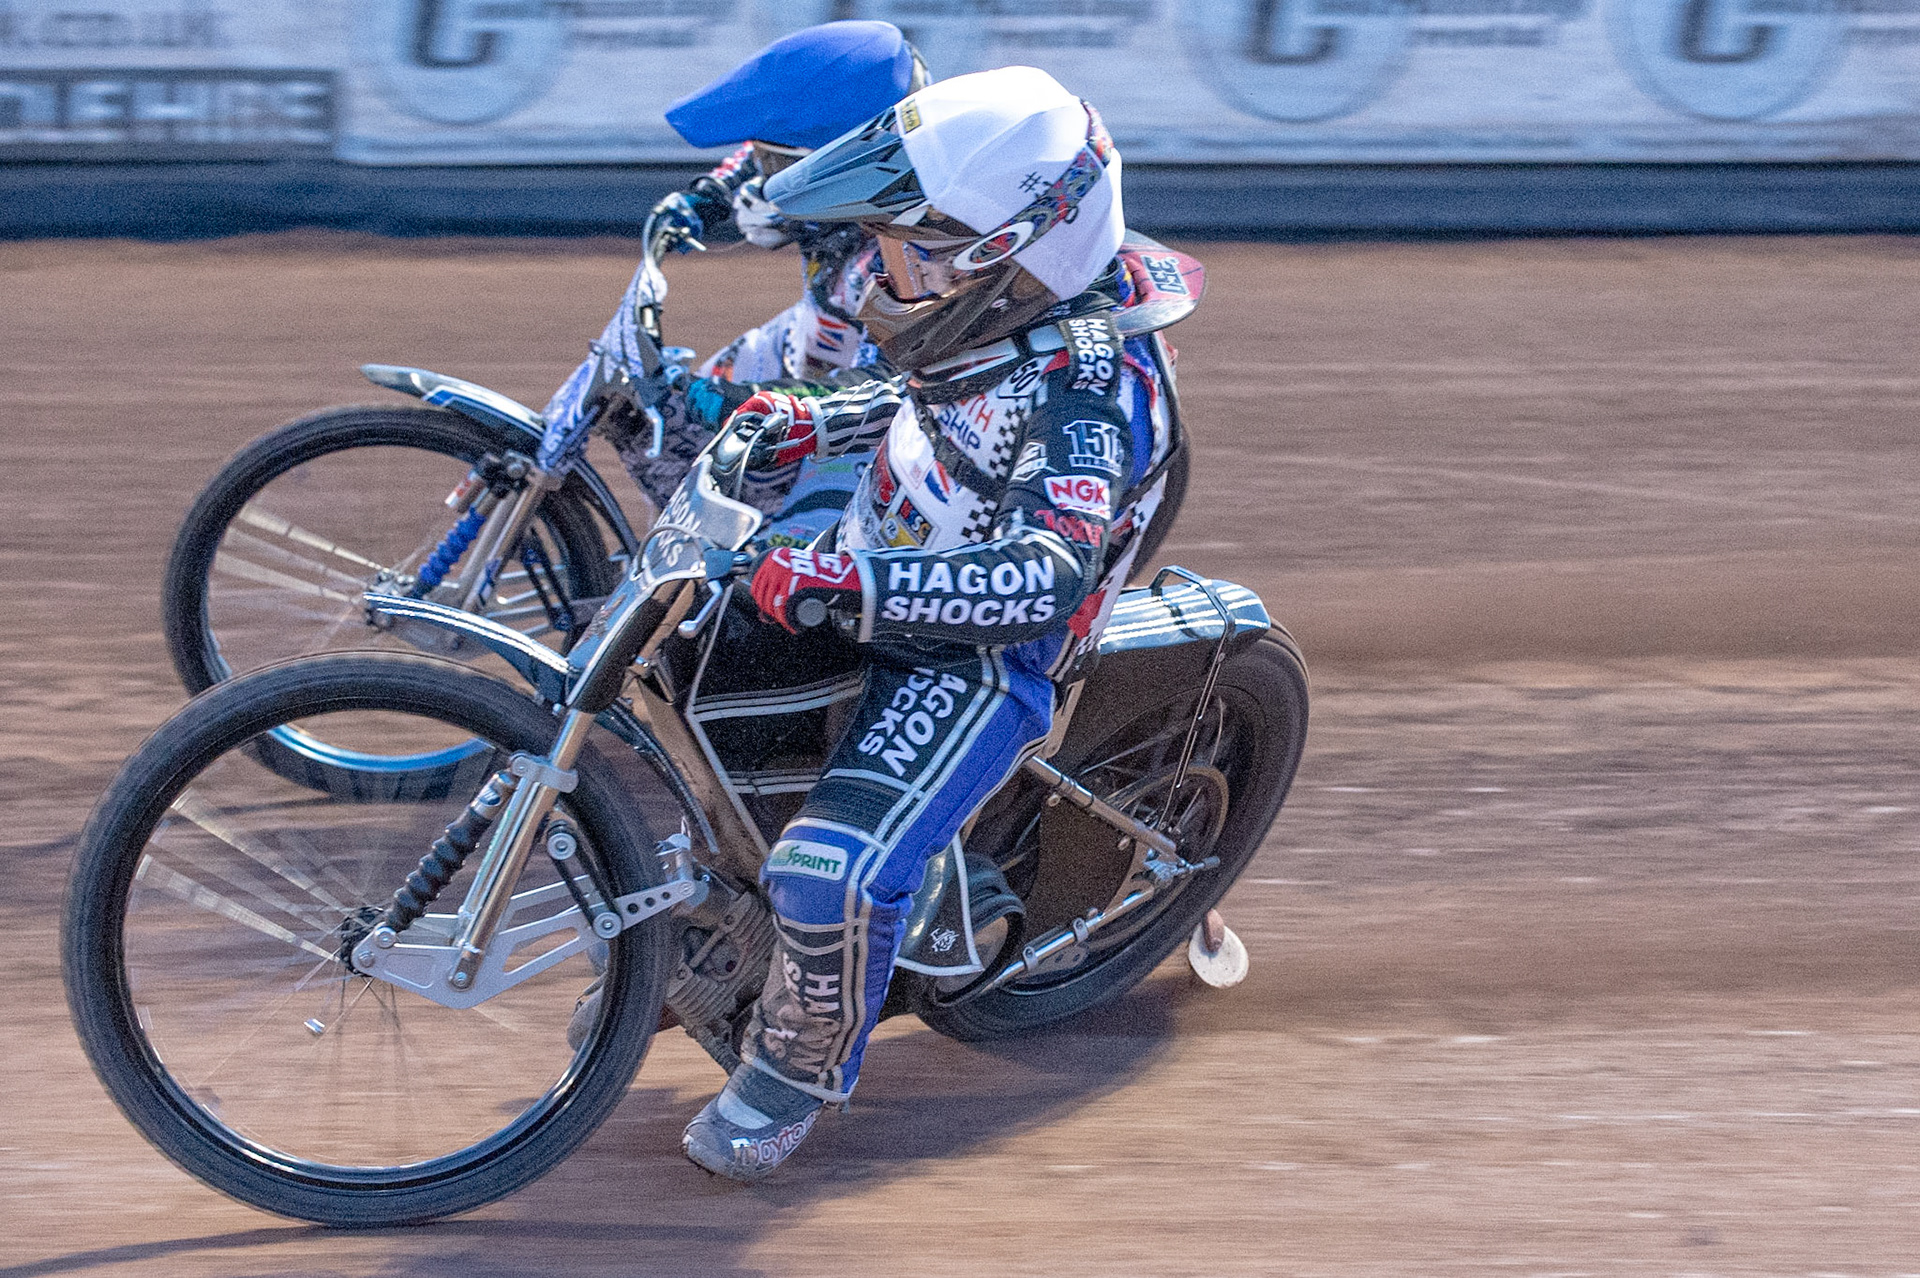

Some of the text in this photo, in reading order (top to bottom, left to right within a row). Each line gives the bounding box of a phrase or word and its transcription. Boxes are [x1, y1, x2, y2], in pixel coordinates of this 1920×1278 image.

[1067, 319, 1096, 390] SHOCKS
[1086, 318, 1115, 396] HAGON
[1050, 479, 1106, 505] NGK
[888, 555, 1056, 596] HAGON
[881, 594, 1057, 627] SHOCKS
[880, 672, 968, 777] AGON
[785, 845, 842, 874] SPRINT
